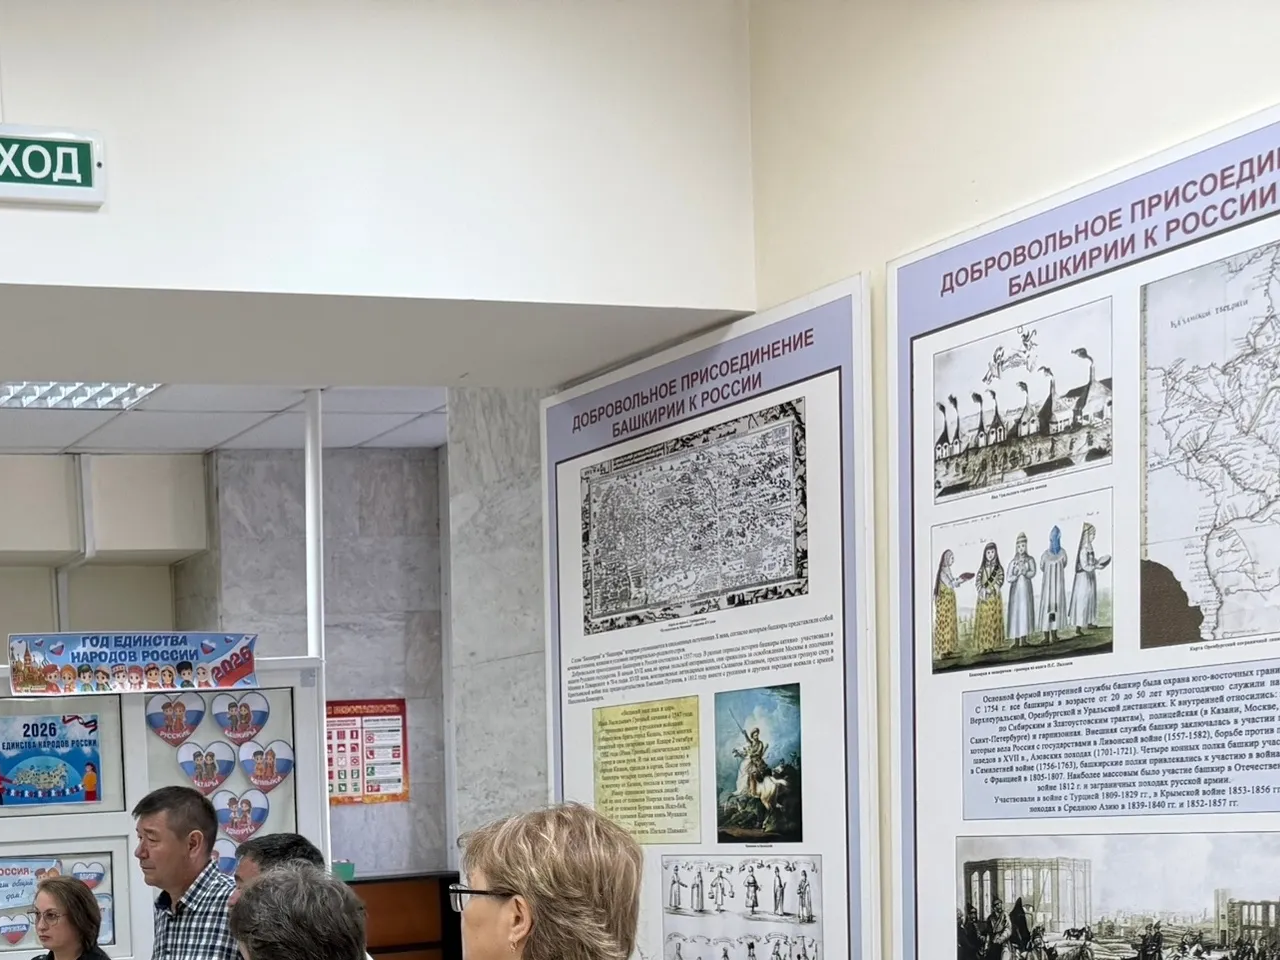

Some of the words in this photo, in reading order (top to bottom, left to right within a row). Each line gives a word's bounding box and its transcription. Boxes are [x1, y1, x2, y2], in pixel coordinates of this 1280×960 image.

[940, 208, 1123, 297] ДОБРОВОЛЬНОЕ
[1008, 232, 1136, 297] БАШКИРИИ
[1144, 228, 1158, 250] К
[1165, 182, 1277, 241] РОССИИ
[572, 379, 677, 434] ДОБРОВОЛЬНОЕ
[681, 328, 814, 392] ПРИСОЕДИНЕНИЕ
[612, 399, 686, 438] БАШКИРИИ
[689, 397, 698, 412] К
[701, 371, 762, 407] РОССИИ
[71, 650, 137, 664] НАРОДОВ
[142, 648, 199, 662] РОССИИ
[81, 636, 110, 648] ГОД
[113, 634, 188, 648] ЕДИНСТВА
[211, 644, 252, 681] 2026
[2, 741, 37, 750] ЕДИНСТВА
[38, 740, 69, 749] НАРОДОВ
[71, 739, 97, 747] РОССИИ
[22, 722, 57, 738] 2026
